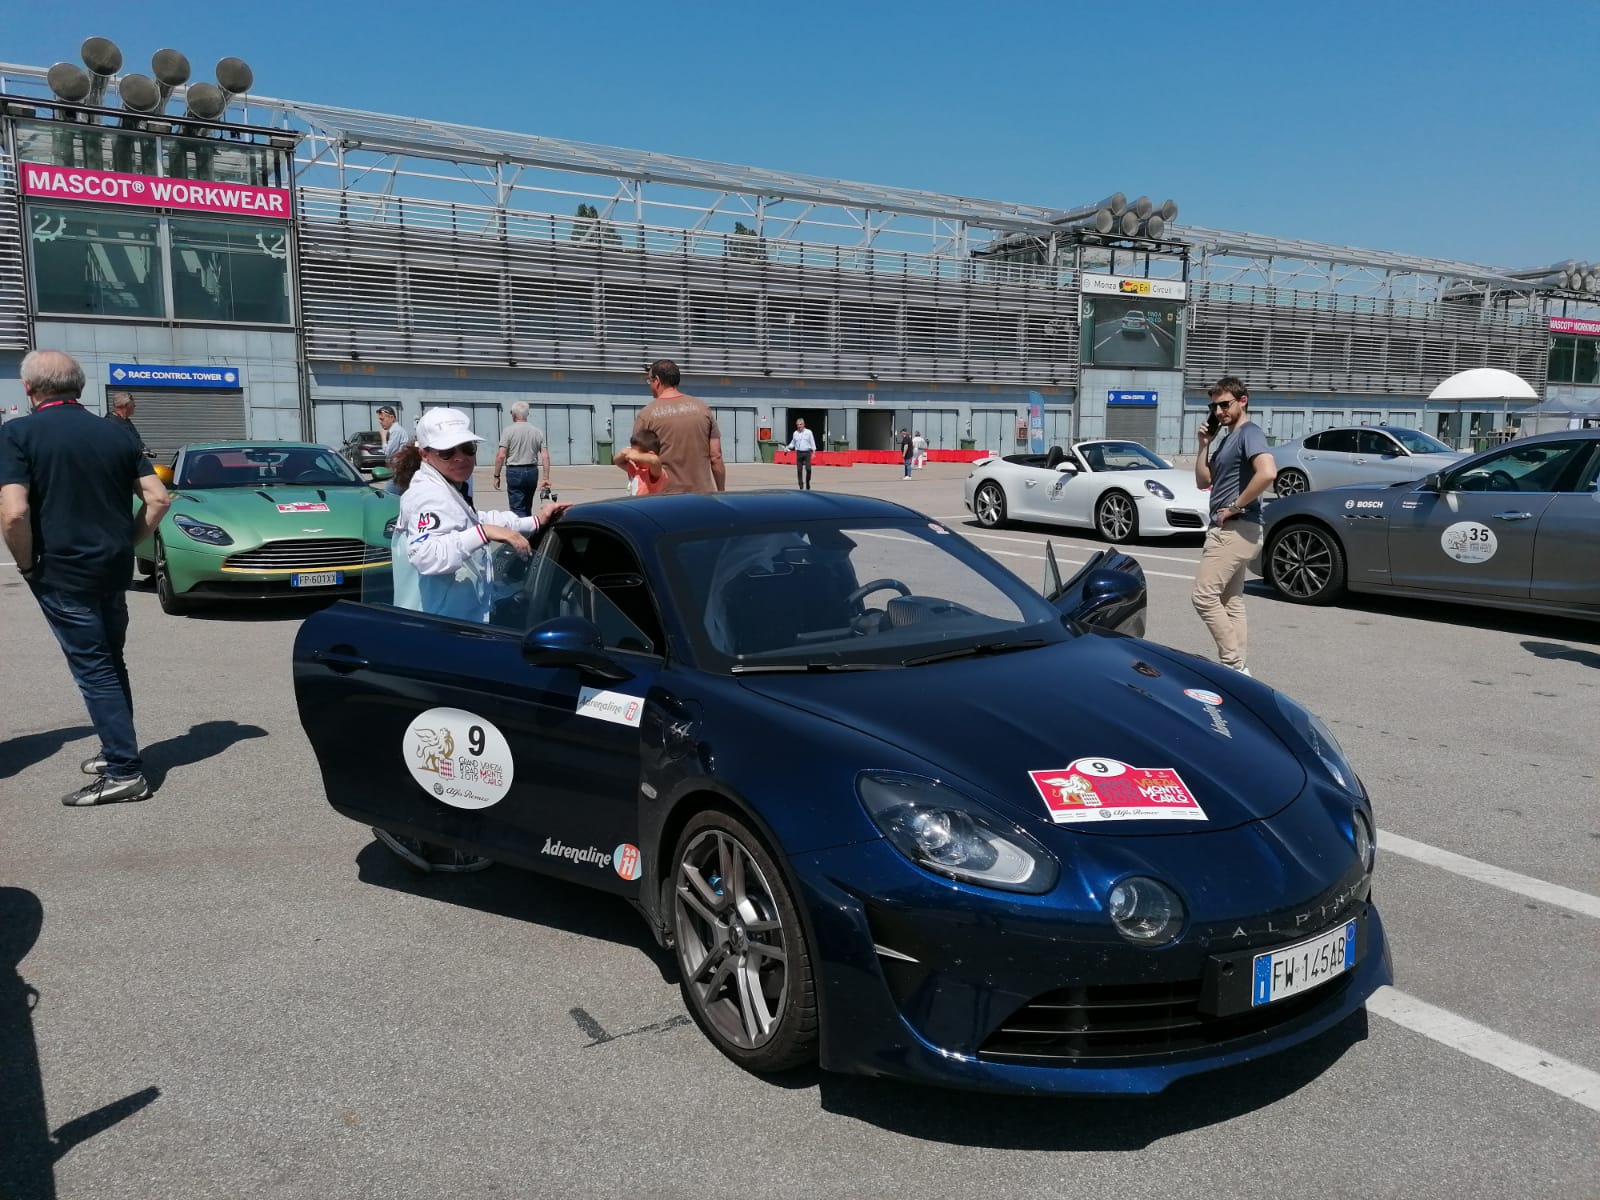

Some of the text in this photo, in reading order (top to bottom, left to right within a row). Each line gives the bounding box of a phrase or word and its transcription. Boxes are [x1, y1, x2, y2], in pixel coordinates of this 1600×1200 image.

[28, 170, 284, 212] MASCOT® WORKWEAR
[1094, 280, 1117, 290] Monza
[128, 370, 222, 381] RACE CONTROL TOWER
[1356, 501, 1384, 509] BOSCH
[1469, 527, 1489, 542] 35
[468, 725, 486, 756] 9
[1092, 762, 1109, 773] 9
[1138, 785, 1185, 797] MONTE
[541, 836, 612, 868] Adrenaline
[625, 847, 637, 857] 24
[621, 857, 635, 876] H
[1303, 936, 1346, 982] 145AB
